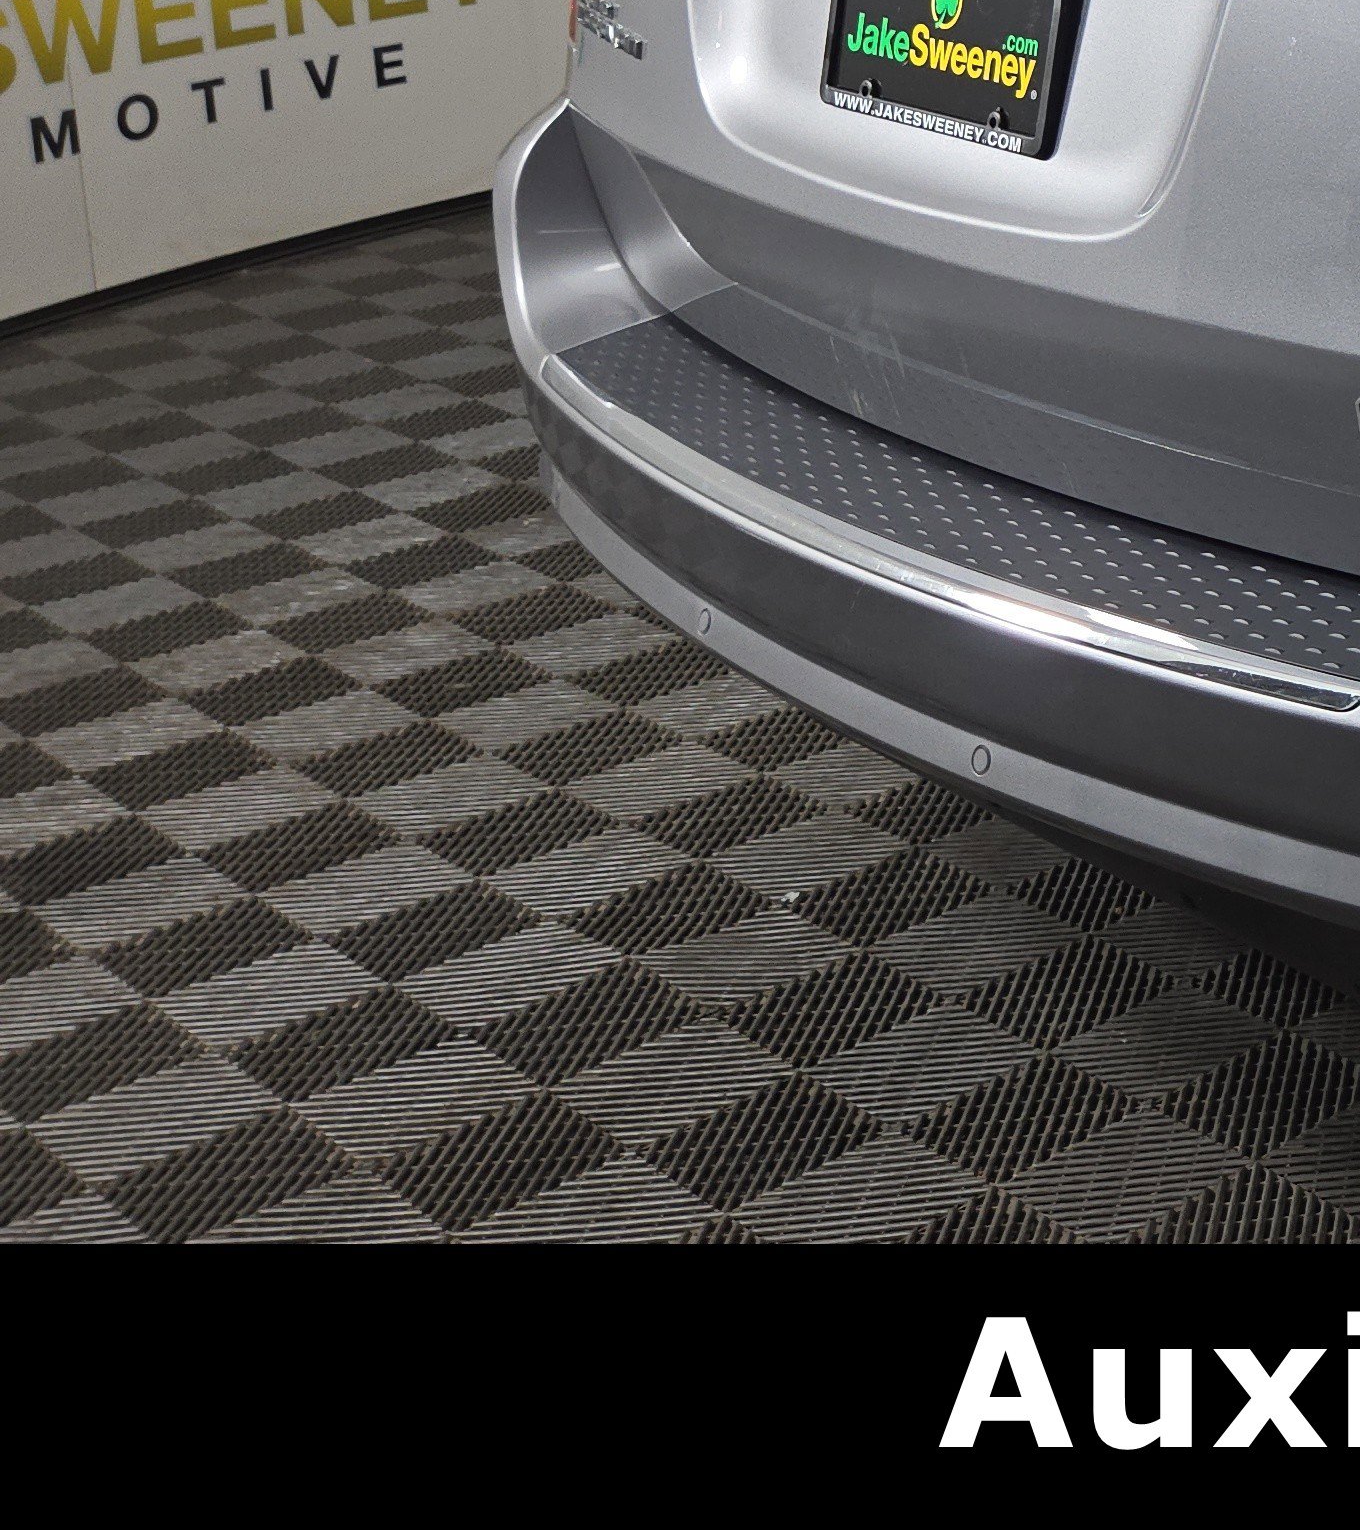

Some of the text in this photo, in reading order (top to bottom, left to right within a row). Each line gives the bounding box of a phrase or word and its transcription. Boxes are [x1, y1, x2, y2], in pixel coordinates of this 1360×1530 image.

[847, 11, 1039, 99] JakeSweeney .com
[29, 42, 408, 164] MOTIVE
[834, 91, 1022, 153] WWW.JAKESWEENEY.COM
